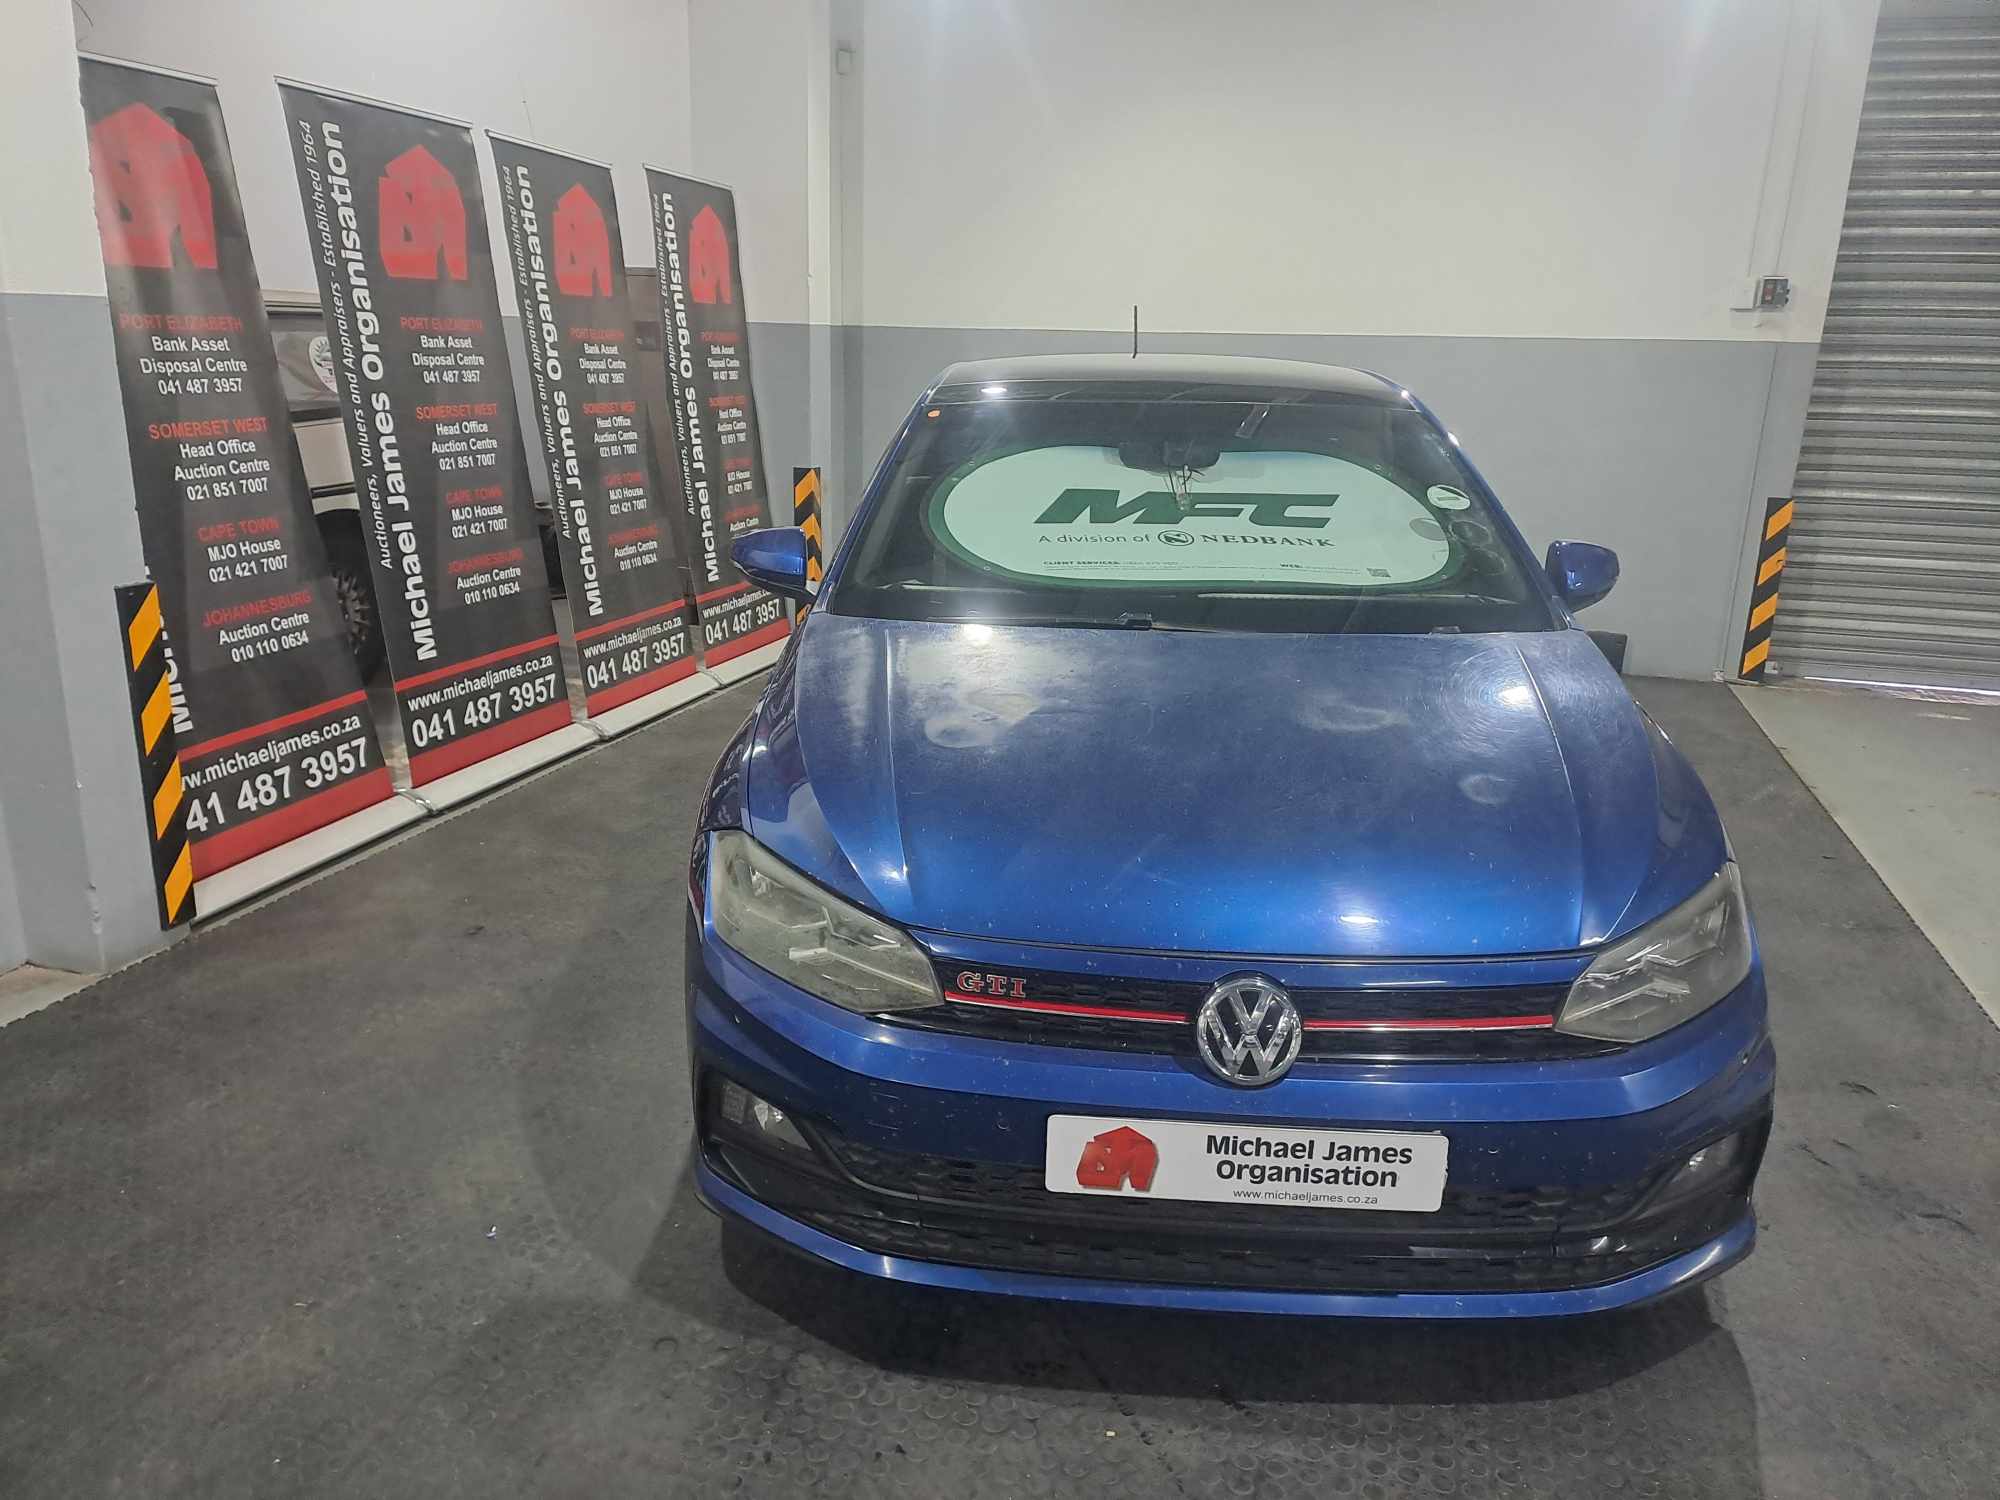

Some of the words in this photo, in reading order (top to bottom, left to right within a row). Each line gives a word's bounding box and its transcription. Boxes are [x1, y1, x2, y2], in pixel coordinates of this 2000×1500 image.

[298, 120, 318, 164] 1964
[307, 168, 336, 268] Established
[322, 122, 384, 381] Organisation
[516, 165, 562, 381] Organisation
[662, 192, 692, 379] Organisation
[330, 282, 356, 370] Appraisers
[152, 336, 187, 351] Bank
[191, 336, 230, 352] Asset
[420, 335, 446, 348] Bank
[448, 336, 472, 348] Asset
[140, 358, 202, 376] Disposal
[206, 357, 248, 372] Centre
[412, 353, 455, 368] Disposal
[457, 353, 484, 366] Centre
[158, 380, 182, 395] 041
[186, 379, 208, 394] 487
[214, 378, 242, 392] 3957
[348, 372, 362, 404] and
[424, 371, 440, 384] 041
[442, 370, 458, 383] 487
[148, 420, 230, 440] SOMERSET
[233, 416, 268, 434] WEST
[352, 408, 374, 468] Valuers
[436, 424, 460, 436] Head
[462, 422, 488, 434] Office
[553, 390, 582, 490] James
[685, 386, 706, 473] James
[180, 442, 214, 458] Head
[218, 438, 256, 454] Office
[371, 391, 410, 512] James
[432, 441, 467, 454] Auction
[470, 438, 498, 450] Centre
[174, 463, 226, 482] Auction
[229, 458, 270, 474] Centre
[440, 458, 455, 471] 021
[458, 456, 474, 468] 851
[476, 454, 496, 466] 7007
[187, 484, 209, 500] 021
[213, 481, 236, 497] 851
[240, 477, 268, 494] 7007
[367, 473, 392, 569] Auctioneers,
[452, 506, 472, 521] MJO
[474, 504, 504, 518] House
[452, 526, 468, 538] 021
[470, 522, 485, 535] 421
[488, 518, 508, 532] 7007
[694, 480, 720, 582] Michael
[1038, 535, 1052, 543] A
[1056, 534, 1127, 543] division
[1132, 532, 1150, 542] of
[1200, 534, 1336, 547] NEDBANK
[208, 544, 236, 562] MJO
[240, 538, 281, 556] House
[569, 500, 604, 617] Michael
[208, 566, 231, 582] 021
[234, 560, 256, 578] 421
[260, 554, 288, 573] 7007
[457, 572, 490, 590] Auction
[492, 566, 522, 580] Centre
[392, 520, 438, 662] Michael
[464, 591, 480, 605] 010
[482, 586, 498, 601] 110
[500, 581, 520, 596] 0634
[218, 621, 268, 645] Auction
[271, 611, 310, 630] Centre
[706, 619, 728, 644] 041
[732, 610, 751, 632] 487
[756, 598, 780, 624] 3957
[232, 645, 254, 662] 010
[256, 638, 278, 656] 110
[282, 632, 309, 650] 0634
[584, 616, 682, 659] www.michaeljames.co.za
[587, 658, 617, 688] 041
[622, 646, 648, 676] 487
[652, 632, 685, 664] 3957
[408, 655, 553, 712] www.michaeljames.co.za
[412, 708, 456, 748] 041
[464, 692, 502, 728] 487
[509, 673, 556, 712] 3957
[182, 715, 361, 791] w.michaeljames.co.za
[186, 792, 226, 832] 41
[238, 765, 291, 812] 487
[300, 736, 366, 788] 3957
[956, 971, 1026, 998] GTI
[1206, 1134, 1315, 1160] Michael
[1322, 1141, 1413, 1164] James
[1216, 1160, 1398, 1188] Organisation
[1233, 1190, 1378, 1206] www.michaeljames.co.za
